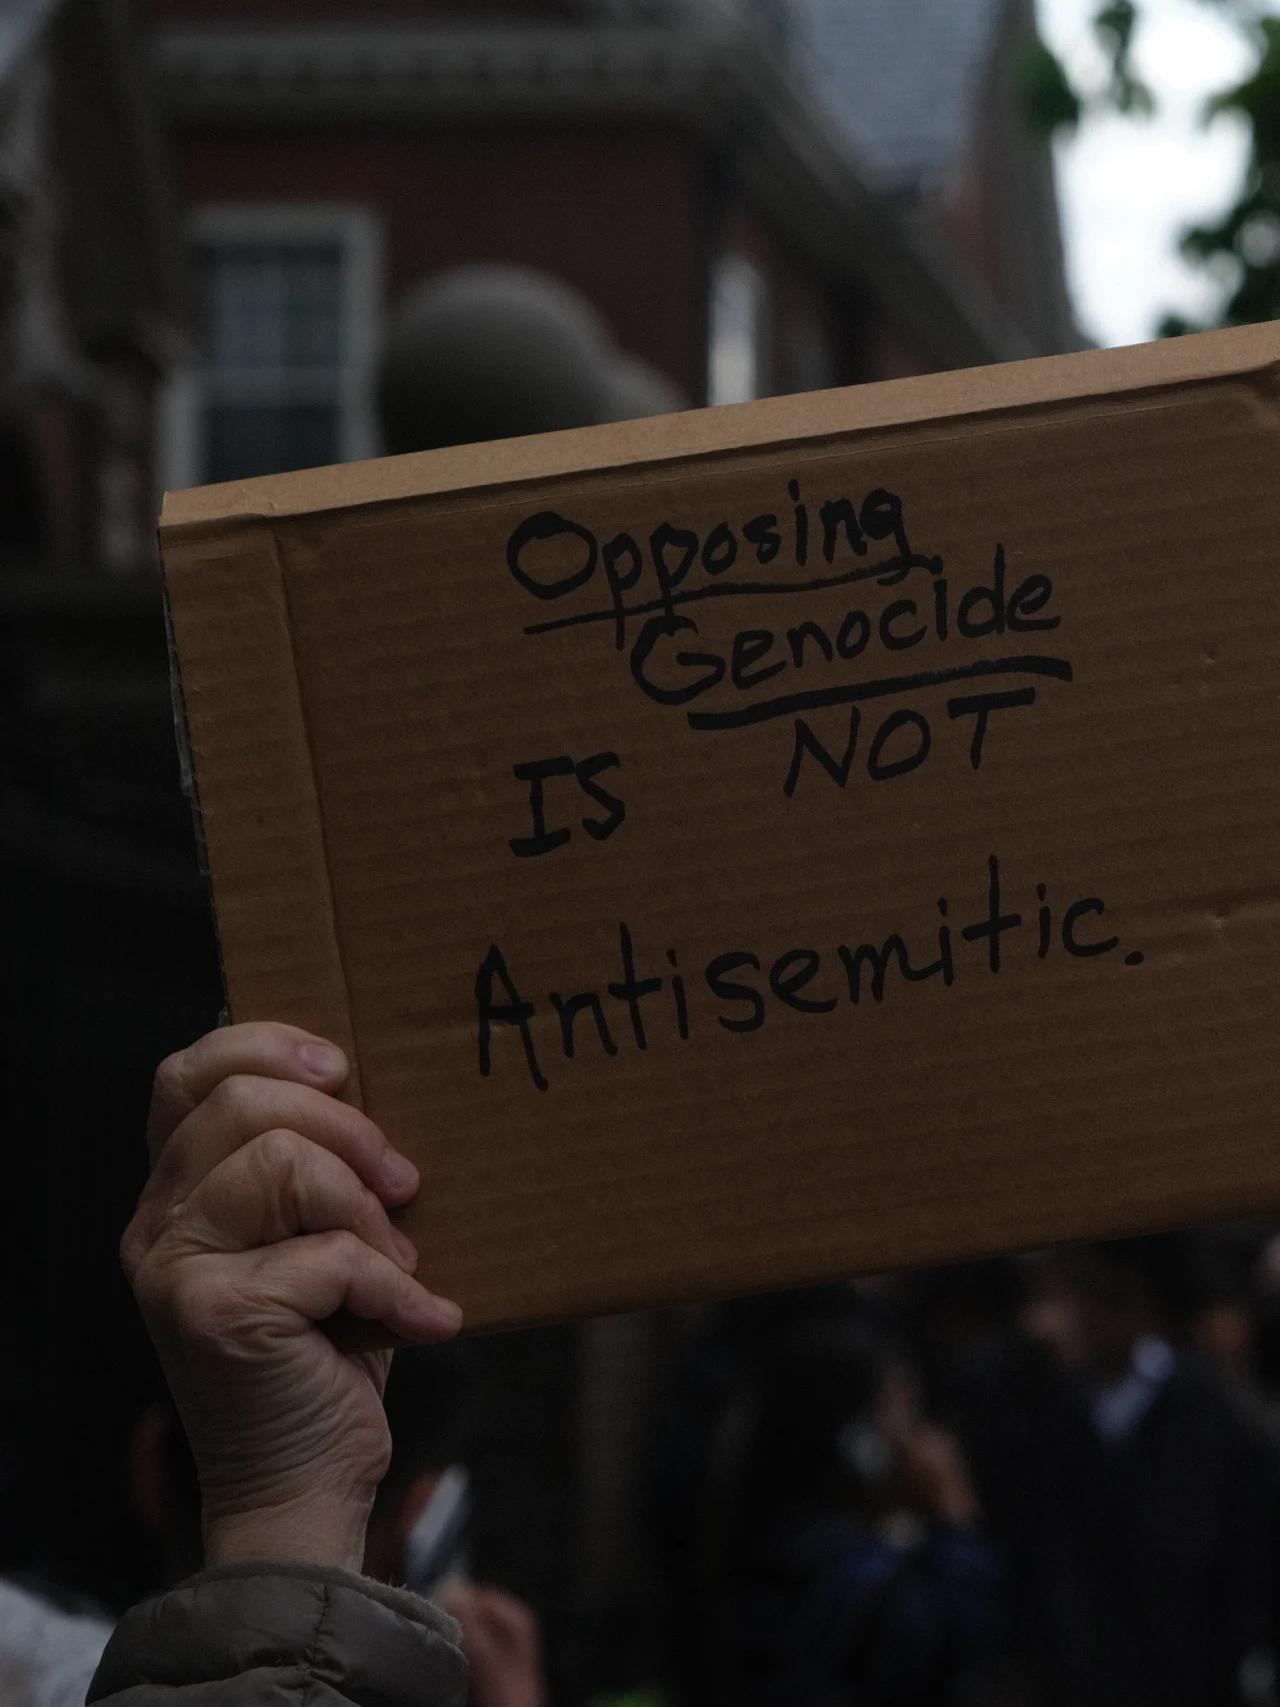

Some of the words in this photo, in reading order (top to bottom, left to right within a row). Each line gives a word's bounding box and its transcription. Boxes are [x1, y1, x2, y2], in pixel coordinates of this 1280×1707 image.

[506, 478, 932, 650] Opposing
[630, 542, 1062, 706] Genocide
[508, 751, 626, 858] IS
[783, 687, 1036, 798] NOT
[474, 854, 1145, 1093] Antisemitic.
